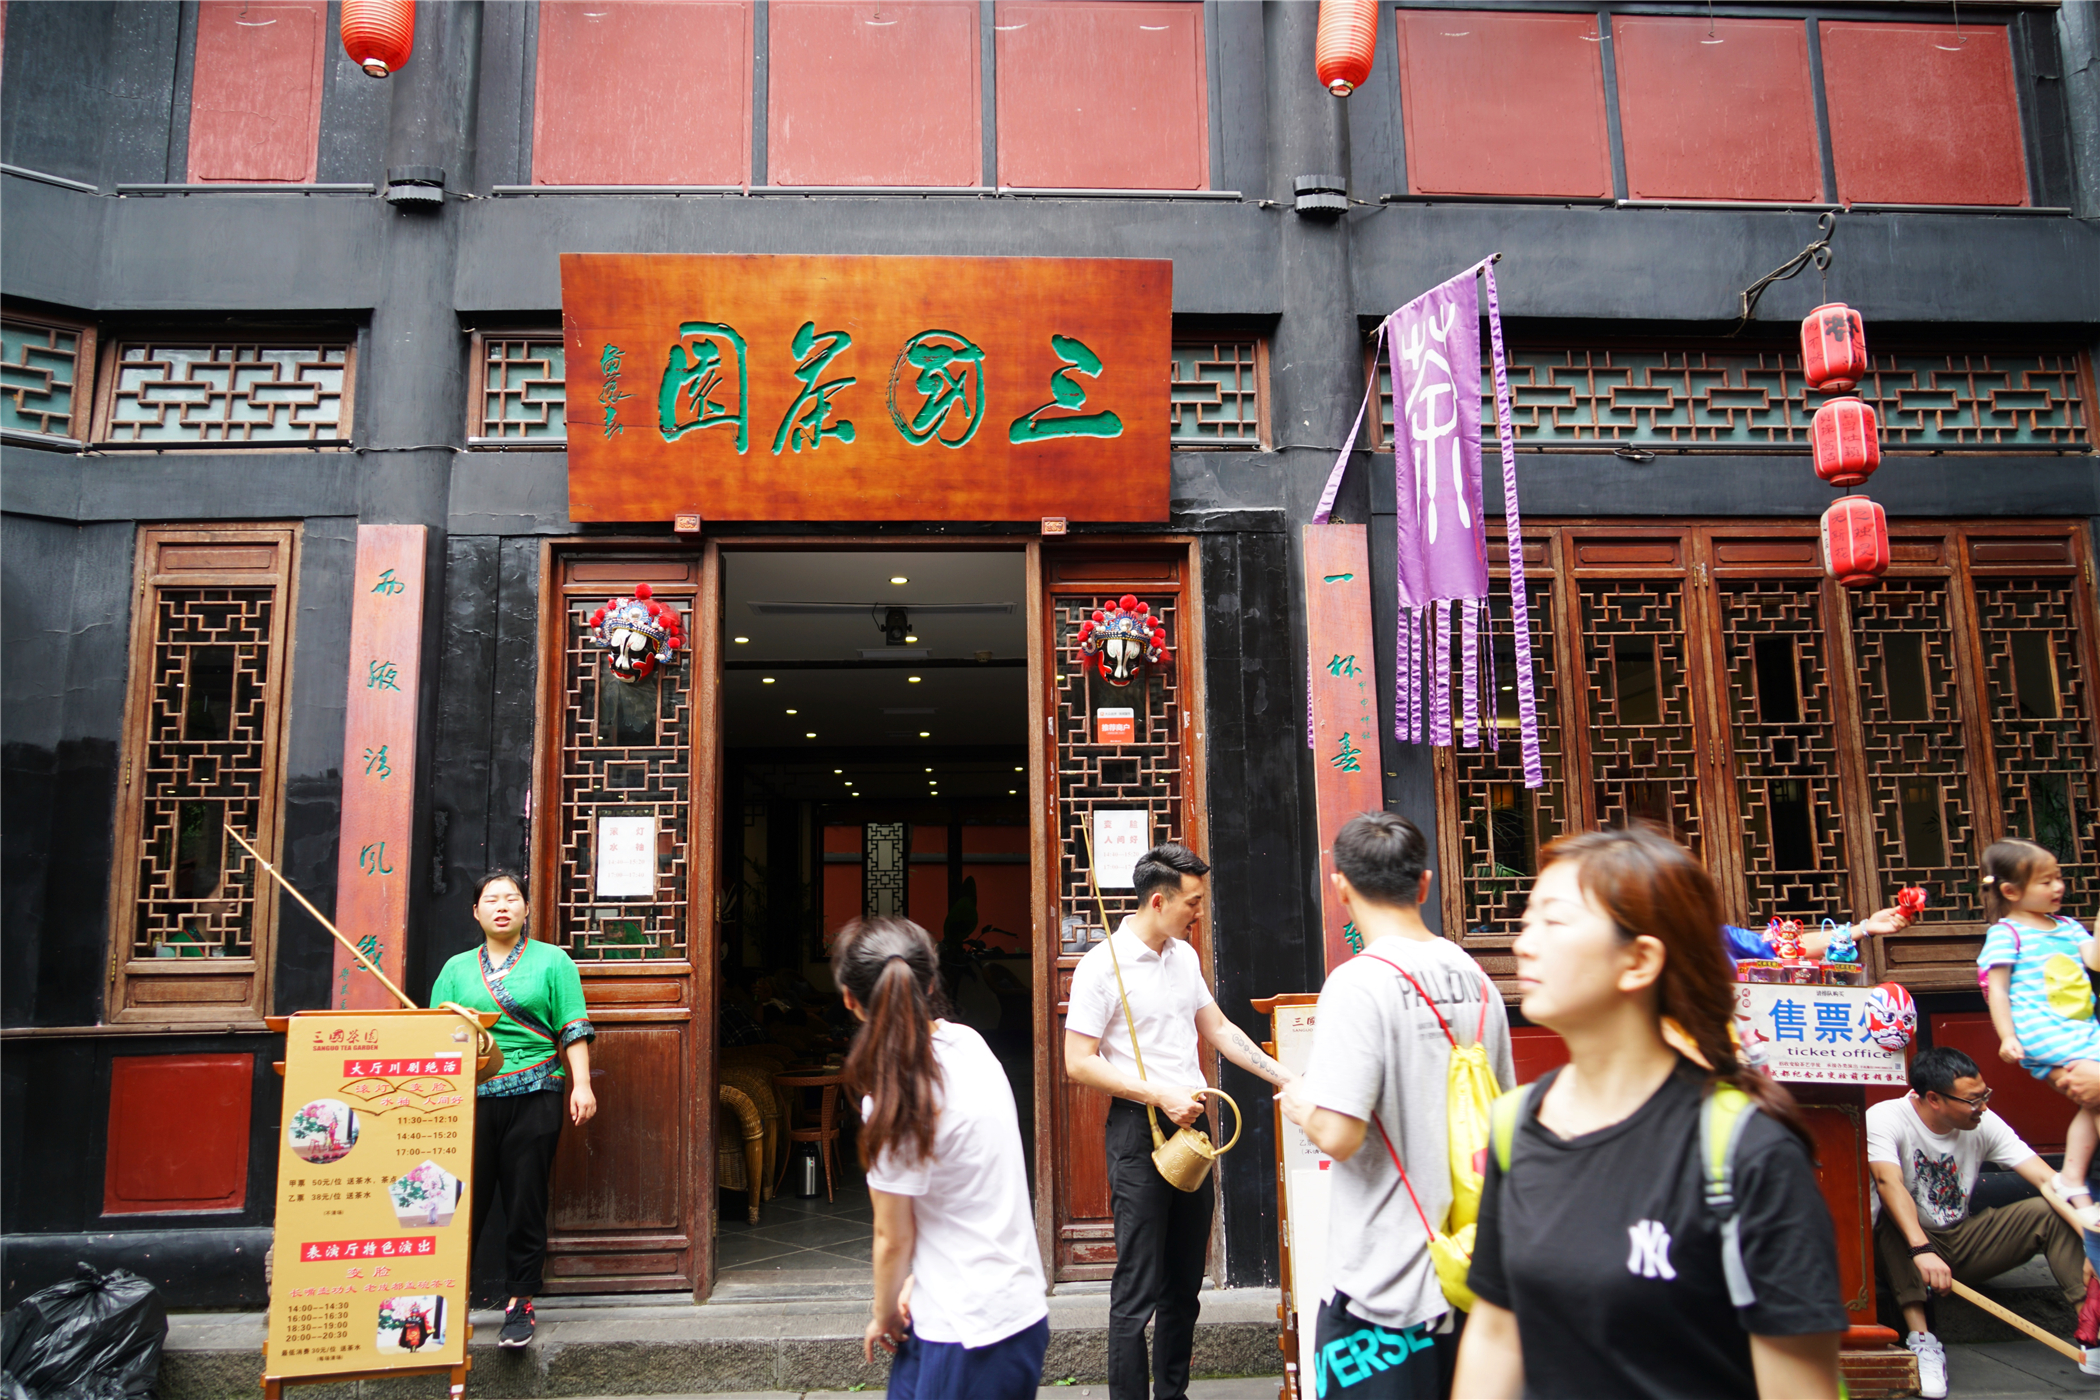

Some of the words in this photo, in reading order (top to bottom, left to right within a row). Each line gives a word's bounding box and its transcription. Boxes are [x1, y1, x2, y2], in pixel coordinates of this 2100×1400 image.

[1104, 835, 1138, 844] 人间好
[1788, 1047, 1837, 1058] ticket
[1842, 1048, 1893, 1059] office
[350, 1060, 457, 1076] 大厅川剧绝活
[355, 1083, 390, 1094] 滚灯
[409, 1082, 447, 1093] 变脸
[380, 1096, 410, 1106] 水袖
[422, 1095, 464, 1106] 人间好
[288, 1179, 306, 1187] 甲票
[312, 1178, 342, 1187] 50元/位
[288, 1194, 305, 1202] 乙票
[311, 1193, 341, 1202] 38元/位
[345, 1191, 372, 1200] 送茶水
[306, 1239, 431, 1259] 表演厅特色演出
[1627, 1219, 1677, 1280] NY
[346, 1265, 392, 1279] 变脸
[281, 1347, 310, 1357] 最低消费
[339, 1344, 361, 1353] 送茶水
